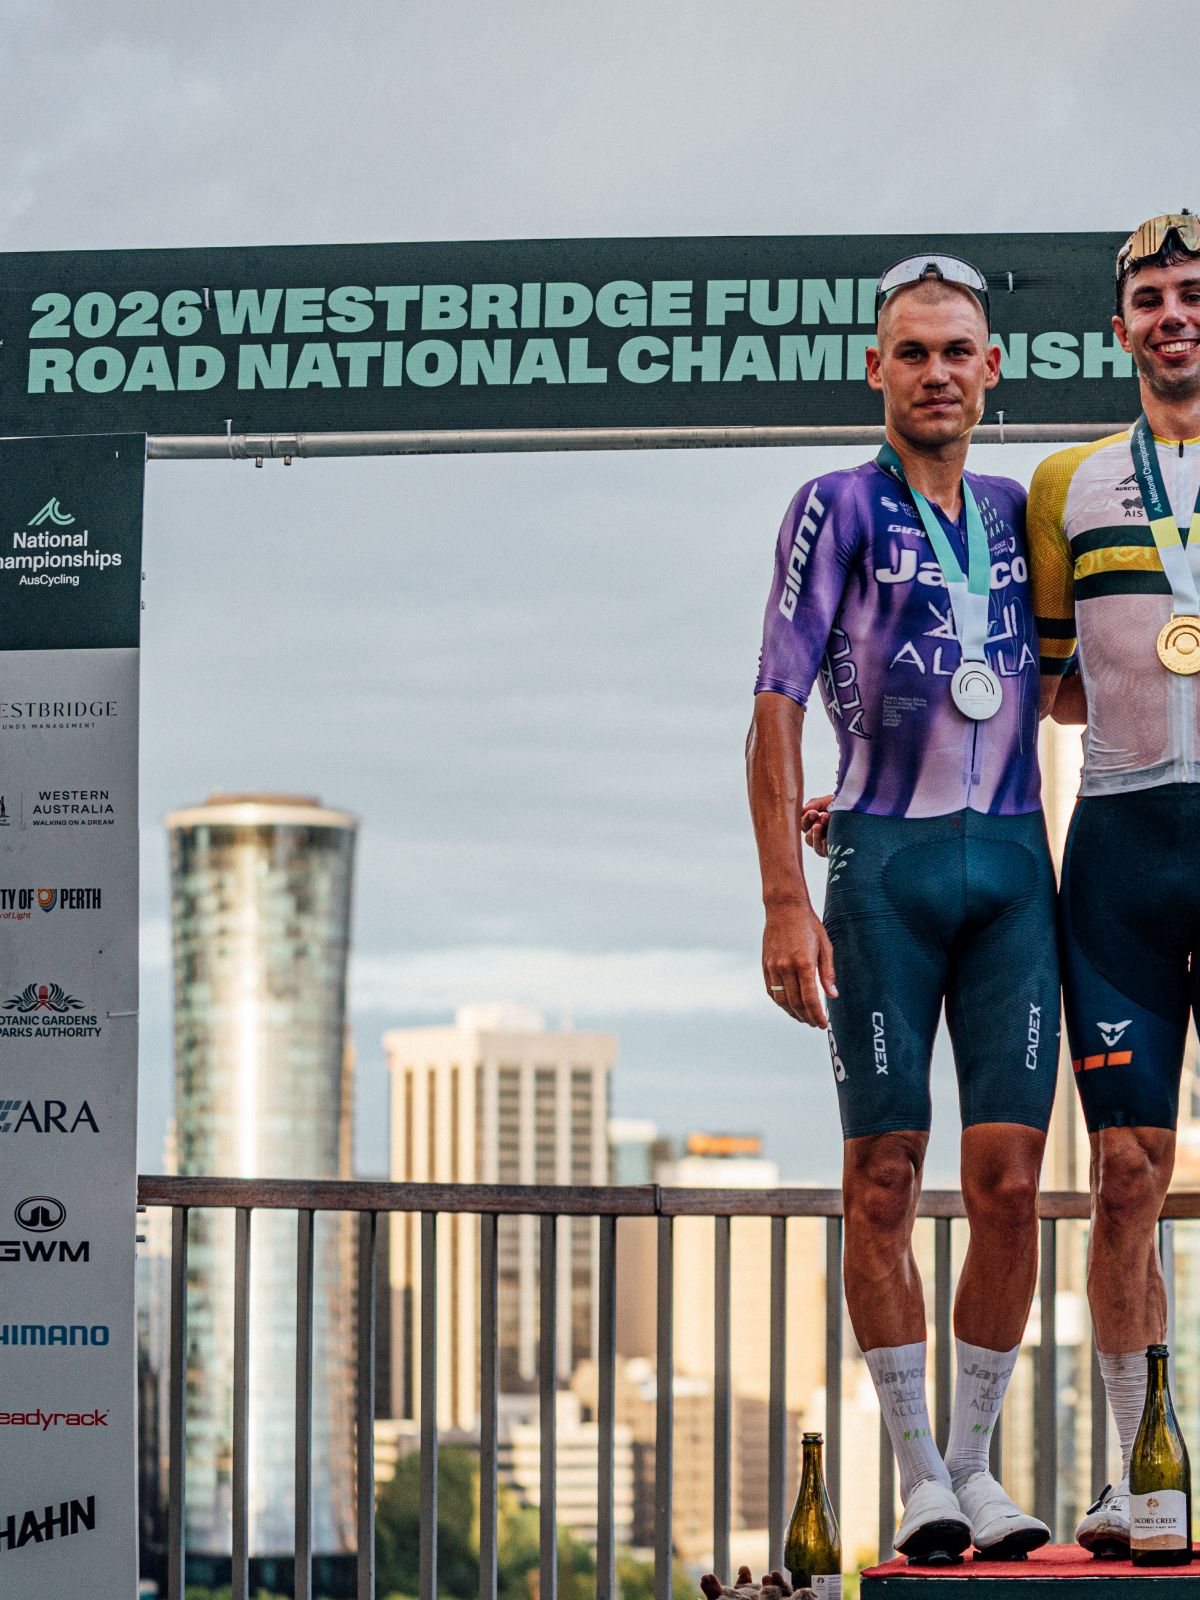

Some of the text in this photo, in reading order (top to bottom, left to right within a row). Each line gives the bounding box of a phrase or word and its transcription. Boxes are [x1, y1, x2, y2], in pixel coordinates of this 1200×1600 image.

[28, 278, 886, 338] 2026 WESTBRIDGE FUN
[28, 346, 225, 393] ROAD
[237, 337, 607, 390] NATIONAL
[1136, 429, 1160, 504] National Championships
[13, 530, 88, 549] National
[779, 481, 825, 623] GIANT
[19, 574, 80, 588] AusCycling
[875, 549, 1028, 590] Jaco
[889, 641, 1037, 678] ALLA
[33, 804, 114, 815] AUSTRALIA
[39, 790, 109, 801] WESTERN
[19, 889, 35, 910] OF
[60, 888, 102, 910] PERTH
[35, 1027, 102, 1038] AUTHORITY
[42, 1015, 98, 1026] GARDENS
[872, 1011, 889, 1075] CADEX
[1025, 1002, 1041, 1071] CADEX
[0, 1241, 90, 1262] GWM
